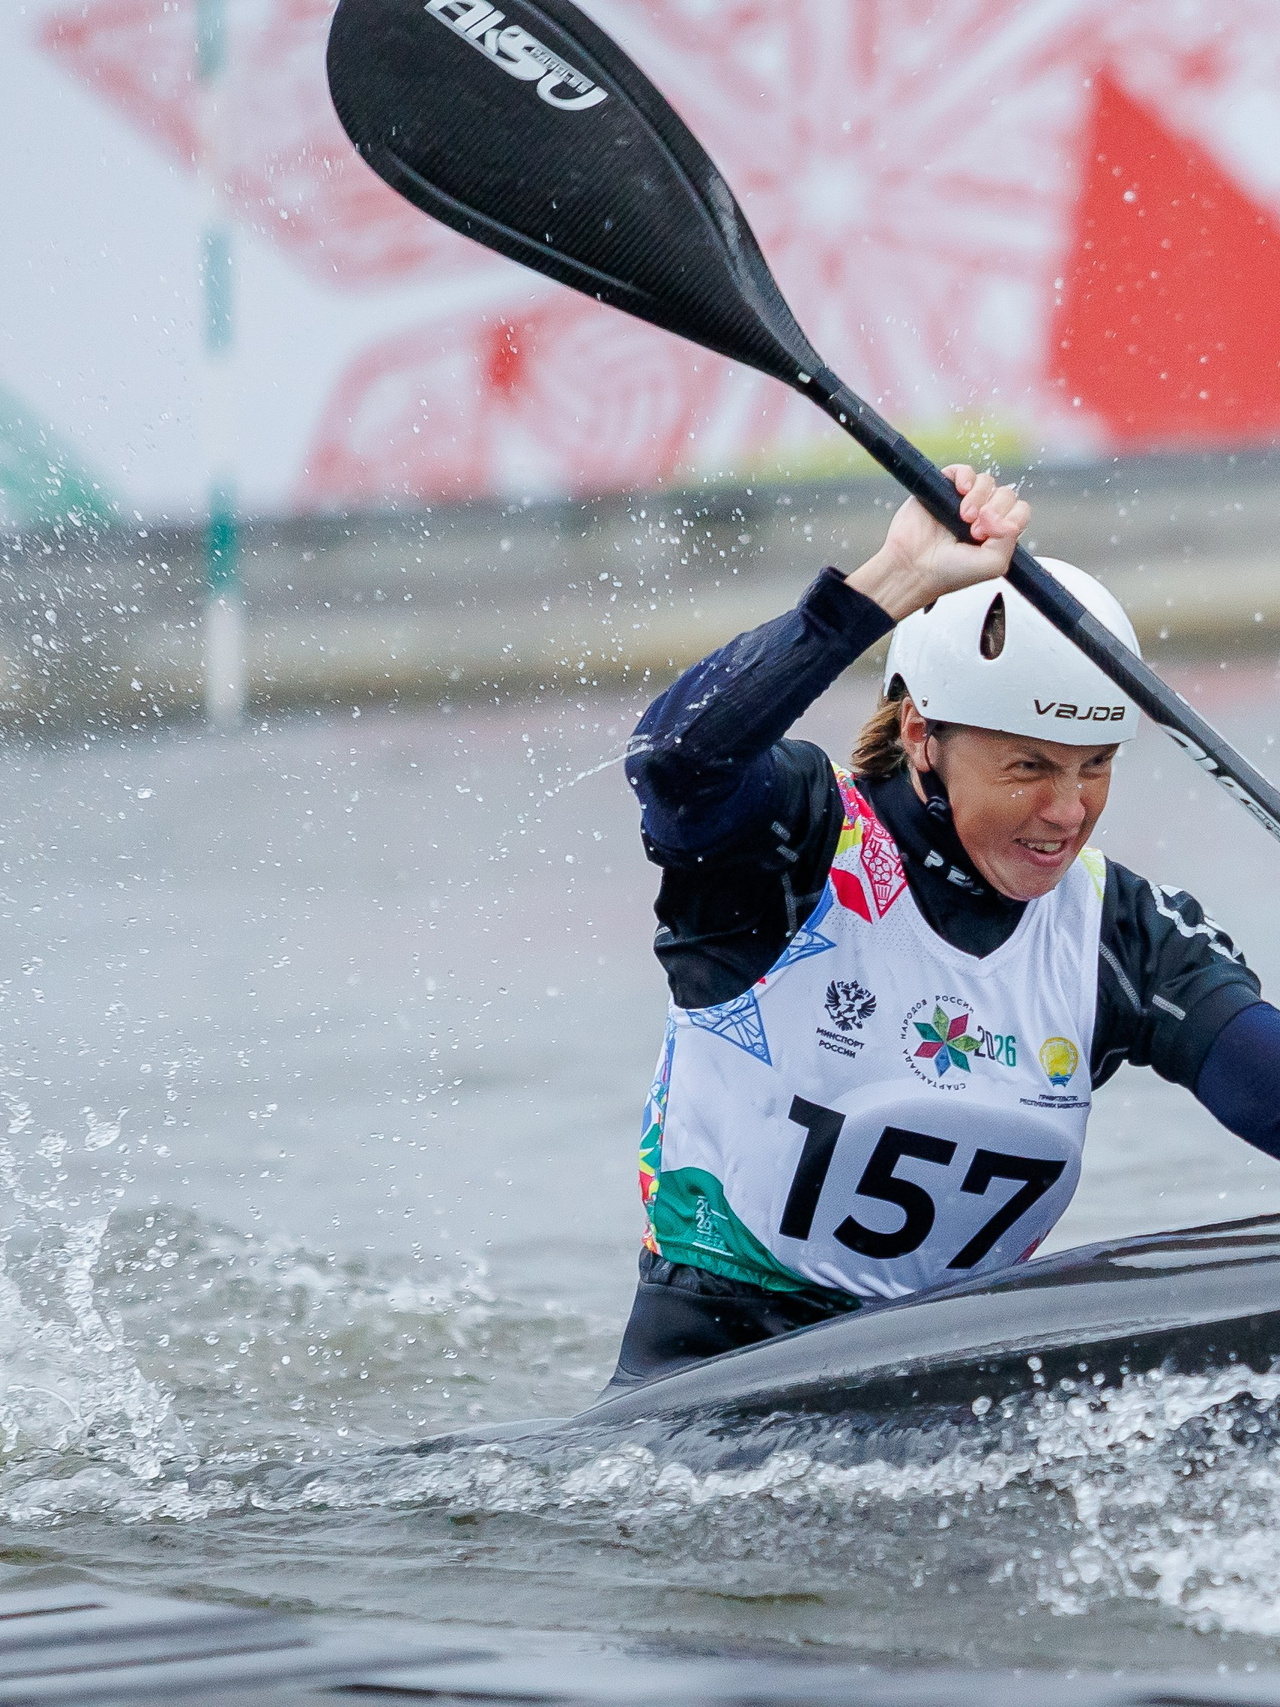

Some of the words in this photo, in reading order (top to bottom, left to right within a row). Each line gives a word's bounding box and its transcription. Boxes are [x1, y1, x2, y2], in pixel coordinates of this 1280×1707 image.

[901, 999, 928, 1040] НАРОДОВ
[935, 995, 976, 1014] РОССИИ
[816, 1027, 865, 1050] МИНСПОРТ
[819, 1040, 857, 1059] РОССИИ
[974, 1025, 1017, 1067] 2026
[902, 1047, 967, 1091] СПАРТАКИАДА
[778, 1094, 1067, 1270] 157
